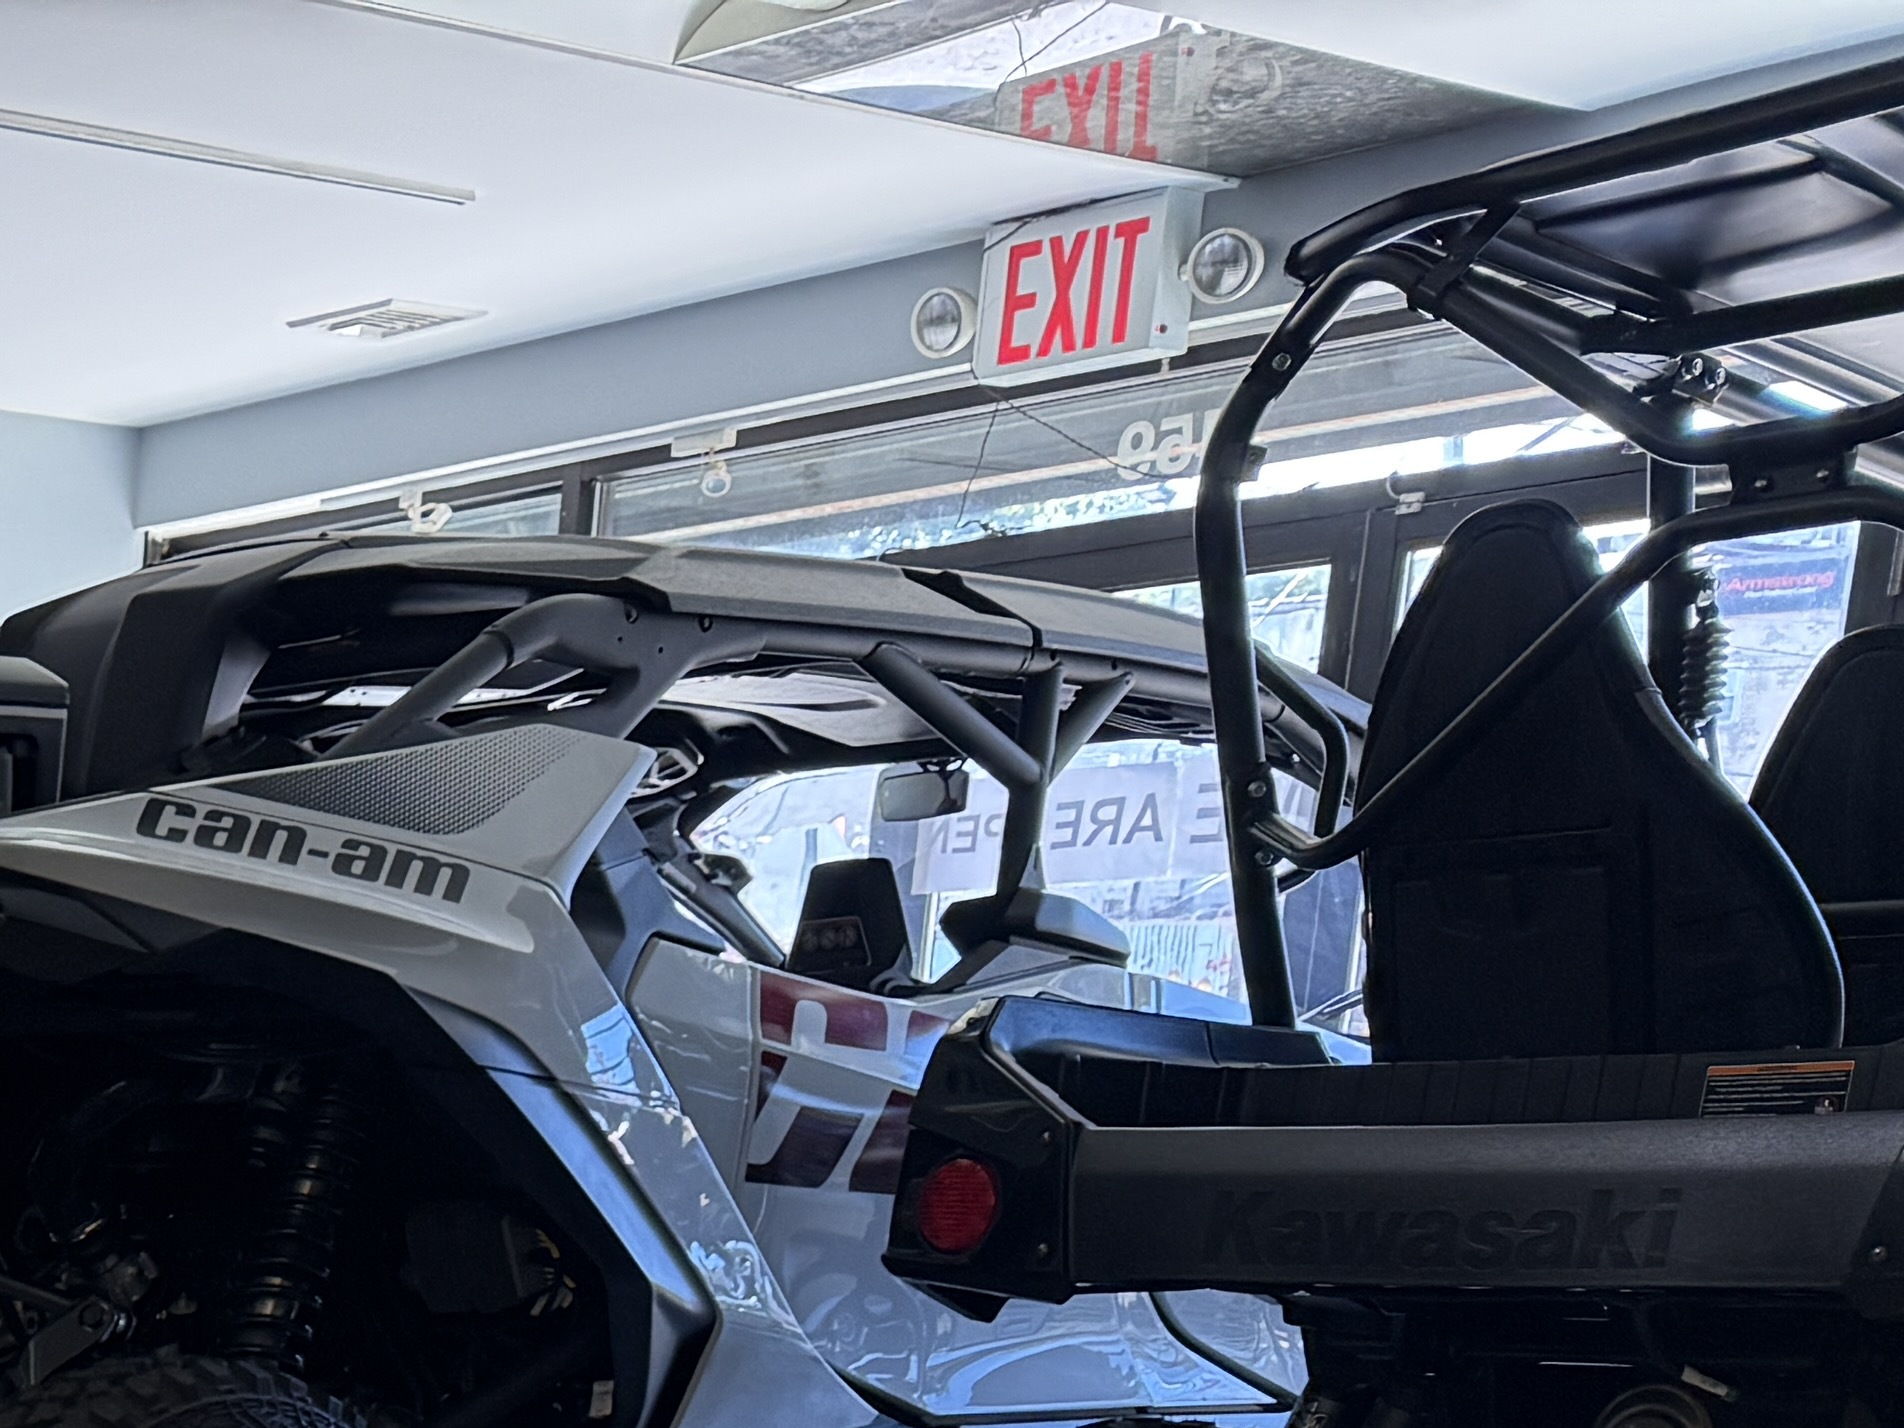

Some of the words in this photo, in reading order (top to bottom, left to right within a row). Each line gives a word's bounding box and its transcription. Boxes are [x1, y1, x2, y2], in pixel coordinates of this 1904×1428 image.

[997, 216, 1151, 366] EXIT
[135, 797, 471, 905] can-am
[1202, 1186, 1684, 1270] Kawasaki
